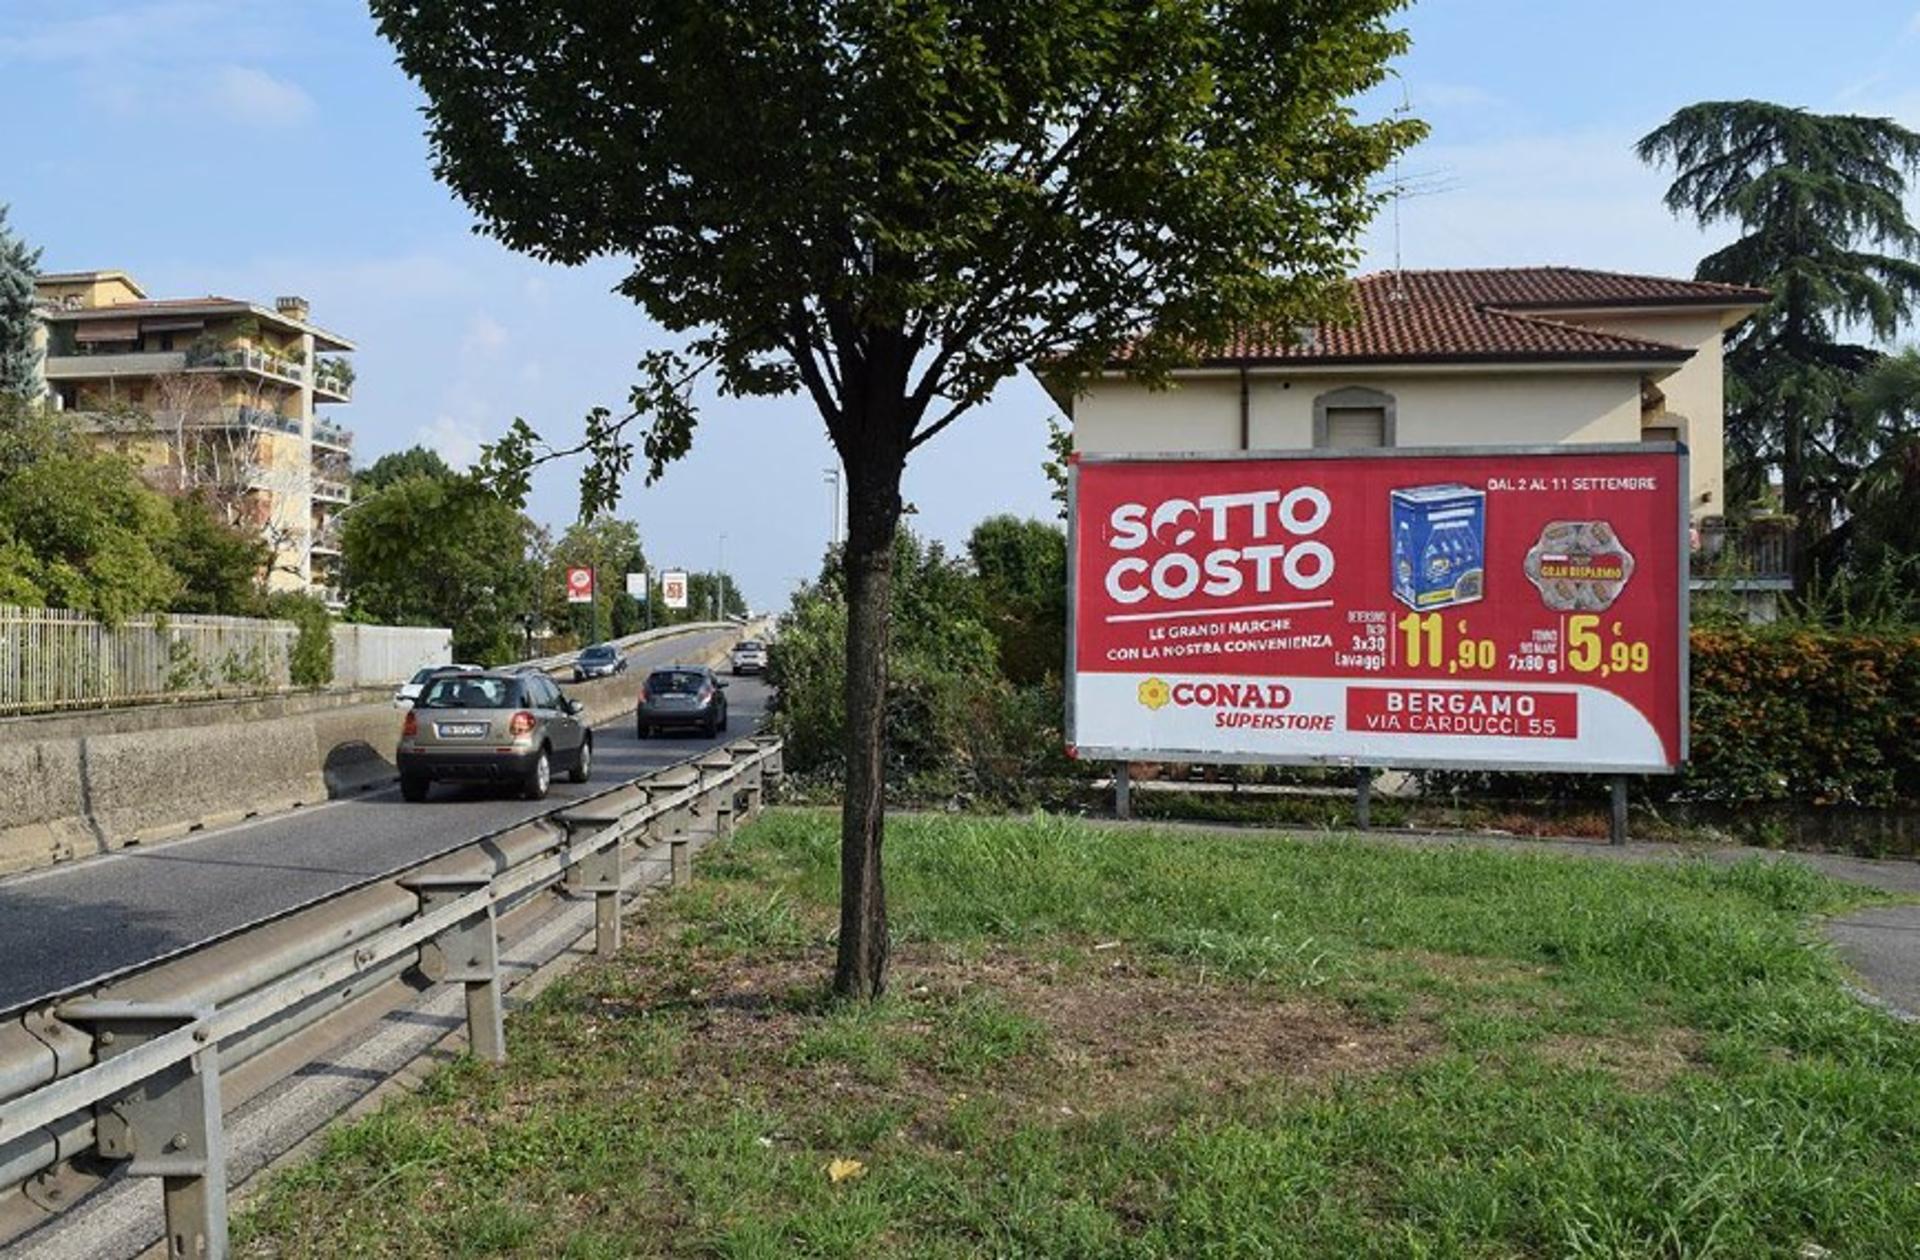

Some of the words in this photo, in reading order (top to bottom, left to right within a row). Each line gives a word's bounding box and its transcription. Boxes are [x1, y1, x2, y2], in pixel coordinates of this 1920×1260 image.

[1487, 478, 1515, 490] DAL
[1518, 478, 1527, 490] 2
[1529, 478, 1548, 490] AL
[1552, 477, 1567, 490] 11
[1572, 477, 1656, 490] SETTEMBRE
[1109, 486, 1332, 550] SOTTO
[1105, 541, 1335, 604] COSTO
[1150, 627, 1164, 640] LE
[1169, 624, 1225, 638] GRANDI
[1228, 619, 1291, 634] MARCHE
[1107, 648, 1139, 661] CON
[1142, 645, 1160, 658] LA
[1163, 642, 1221, 657] NOSTRA
[1224, 635, 1333, 652] CONVENIENZA
[1352, 635, 1386, 651] 3x30
[1172, 683, 1291, 709] CONAD
[1387, 692, 1535, 716] BERGAMO
[1215, 712, 1335, 730] SUPERSTORE
[1366, 714, 1401, 729] VIA
[1410, 715, 1518, 733] CARDUCCI
[1529, 719, 1556, 735] 55
